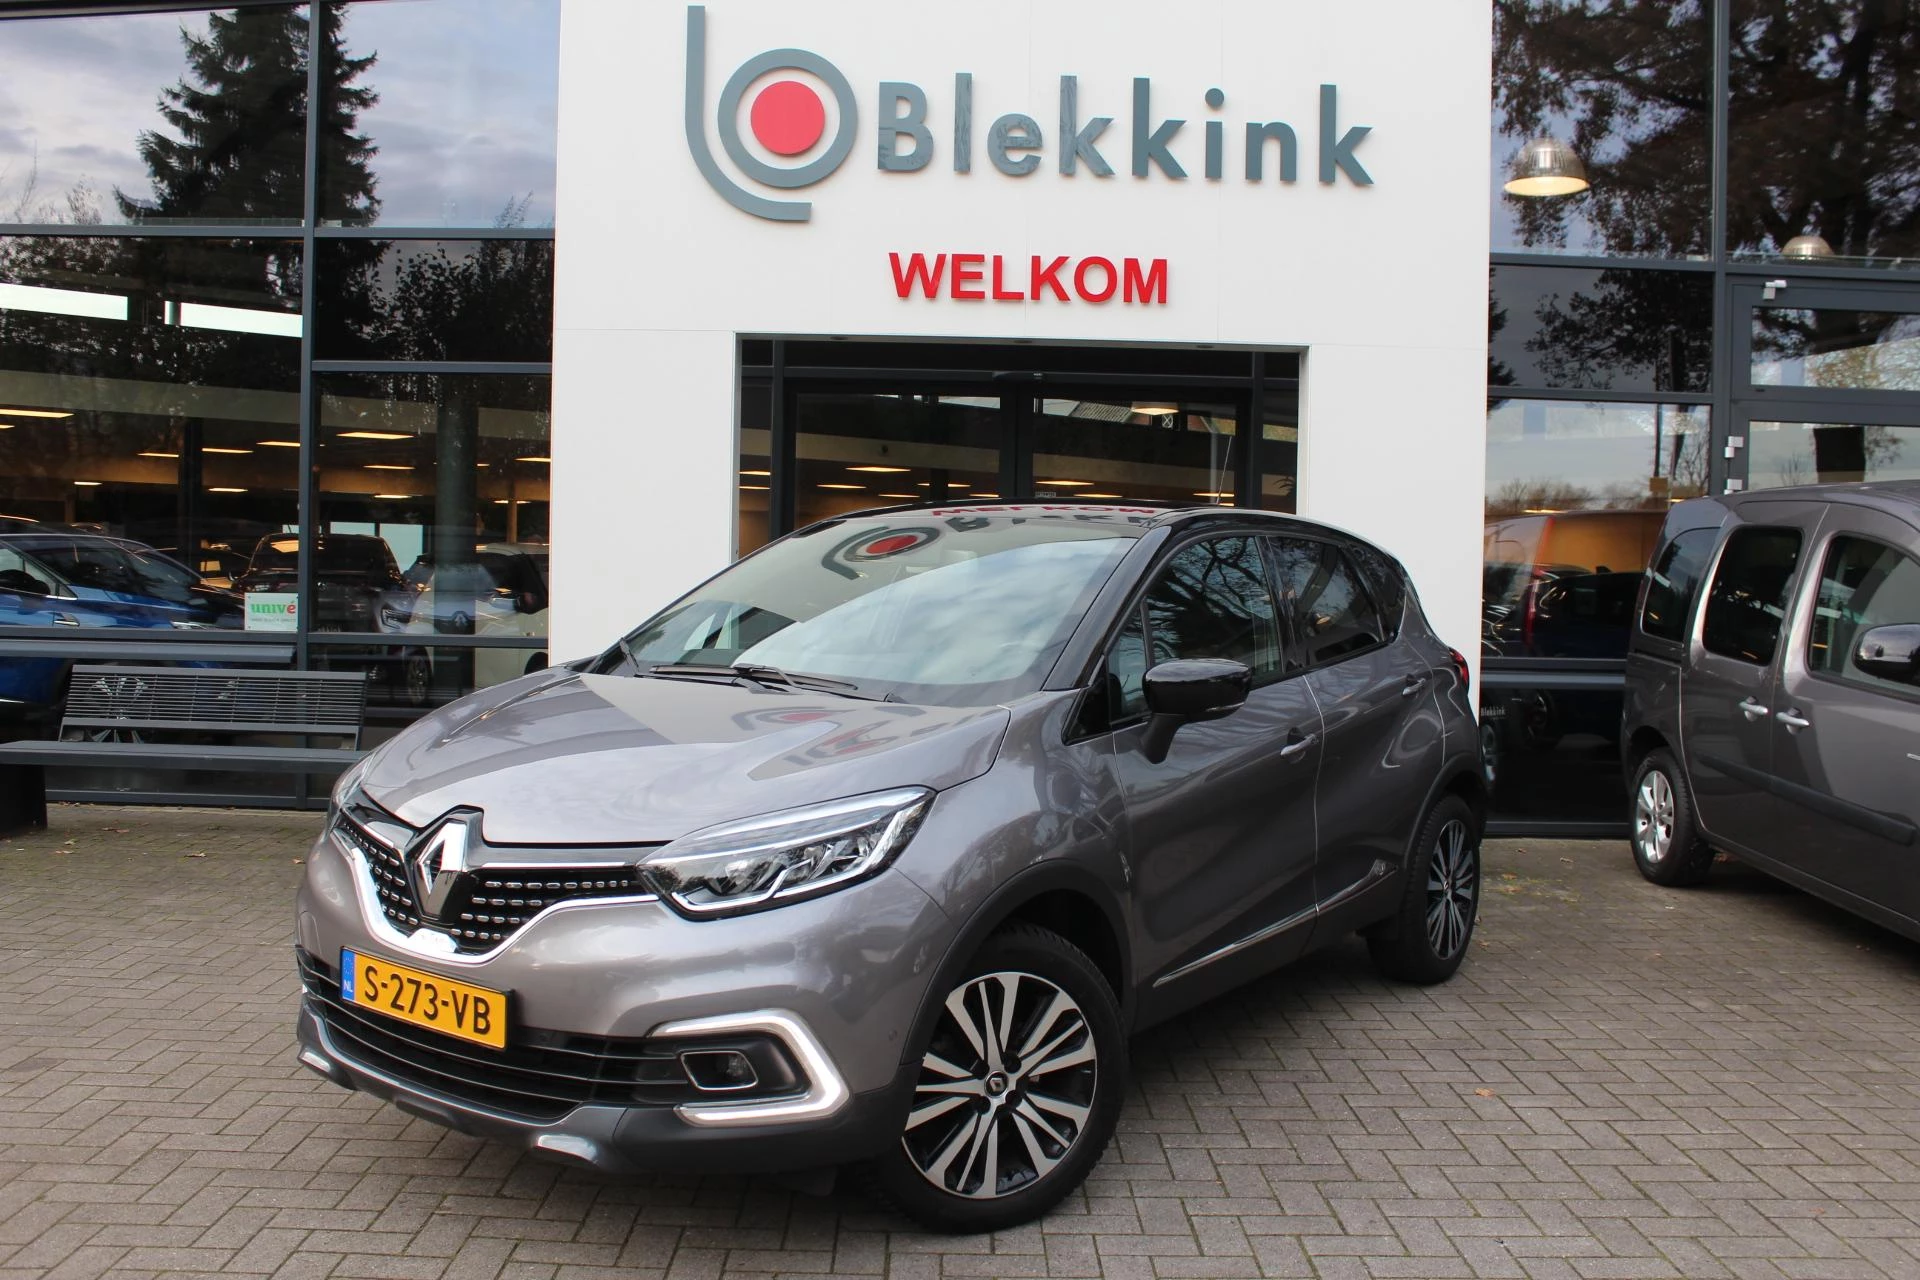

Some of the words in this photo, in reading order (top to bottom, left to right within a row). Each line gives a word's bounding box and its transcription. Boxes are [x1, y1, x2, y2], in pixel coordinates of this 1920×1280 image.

[877, 73, 1374, 185] Blekkink
[889, 252, 1167, 303] WELKOM
[343, 979, 354, 993] NL
[364, 965, 491, 1035] S-273-VB
